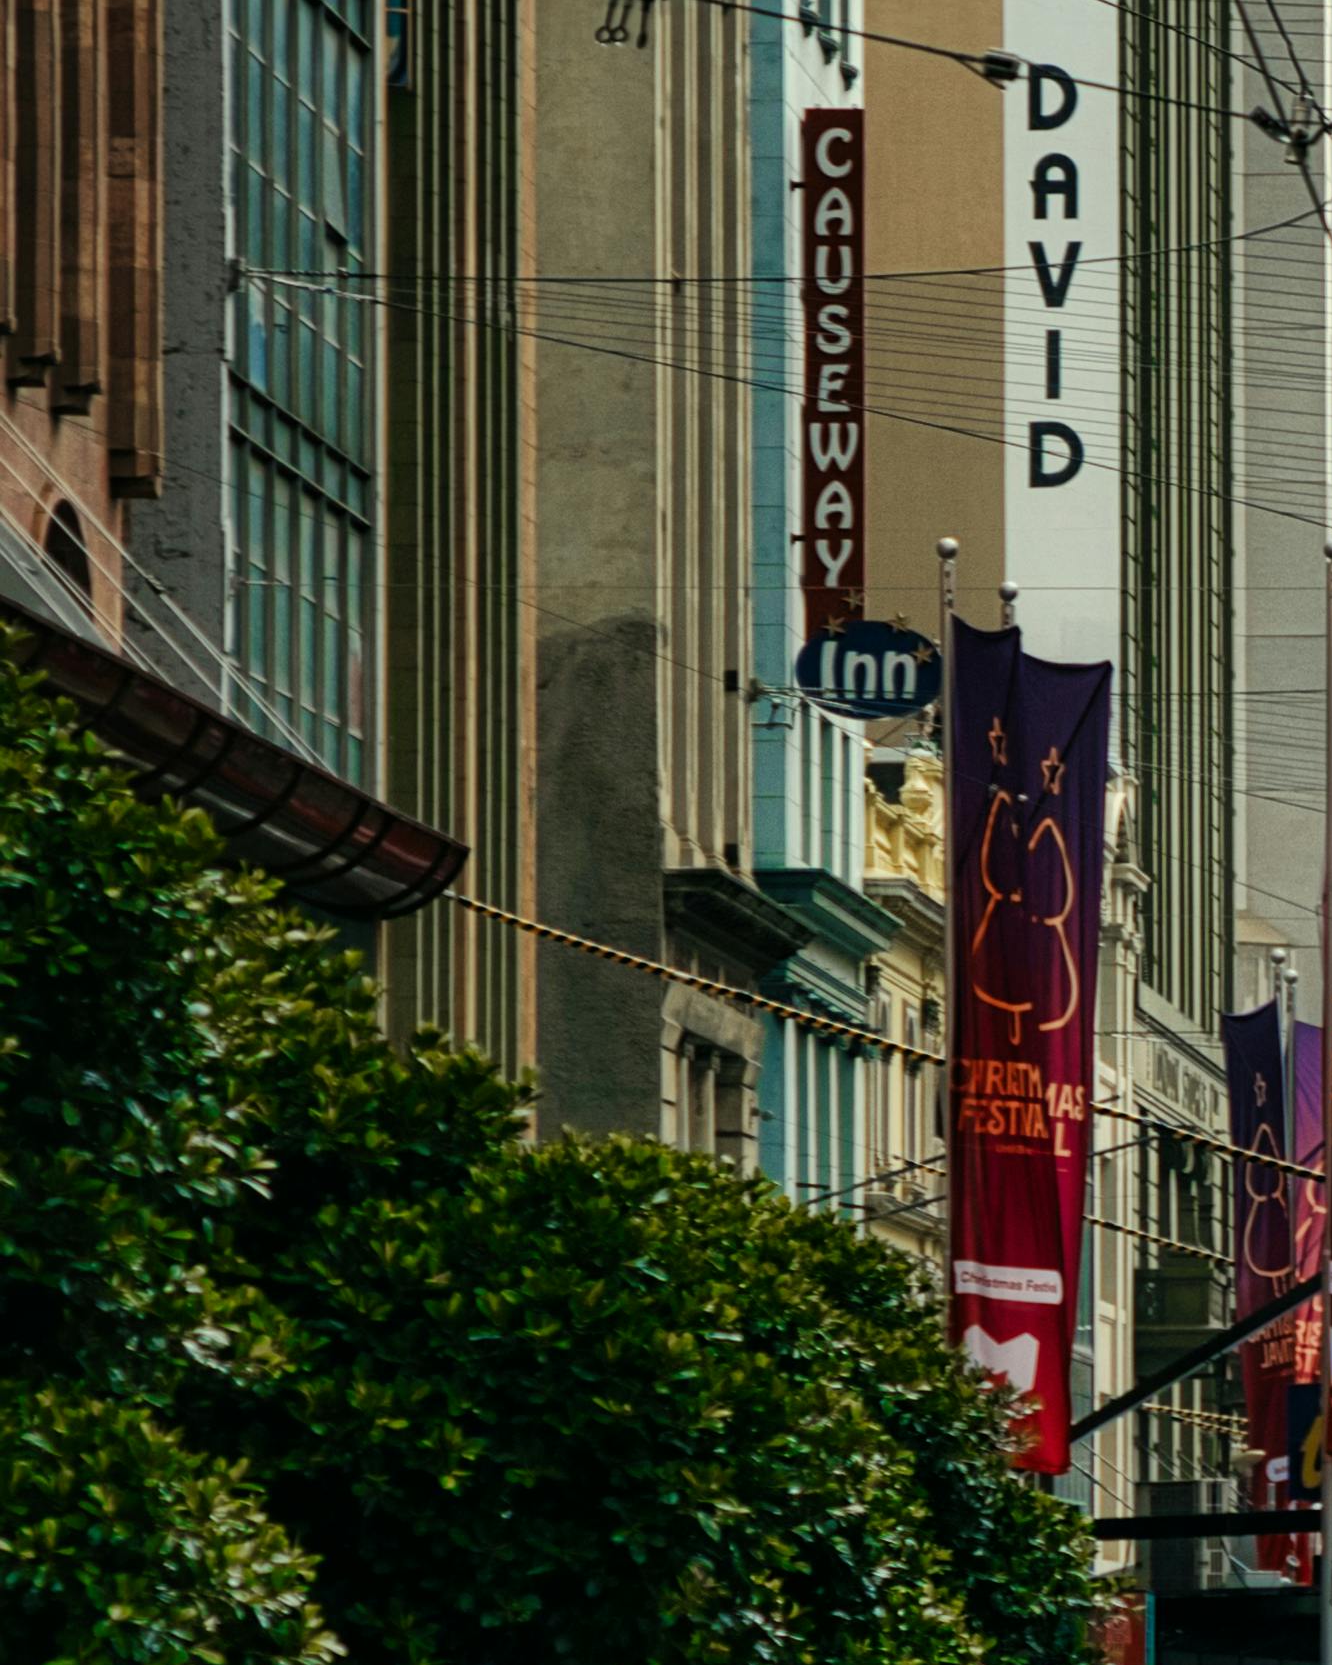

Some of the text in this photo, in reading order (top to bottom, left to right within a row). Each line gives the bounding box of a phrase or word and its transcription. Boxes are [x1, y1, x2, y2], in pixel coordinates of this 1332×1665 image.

[811, 128, 858, 588] CAUSEWAY
[1027, 64, 1084, 488] DAVID
[820, 641, 917, 699] Inn
